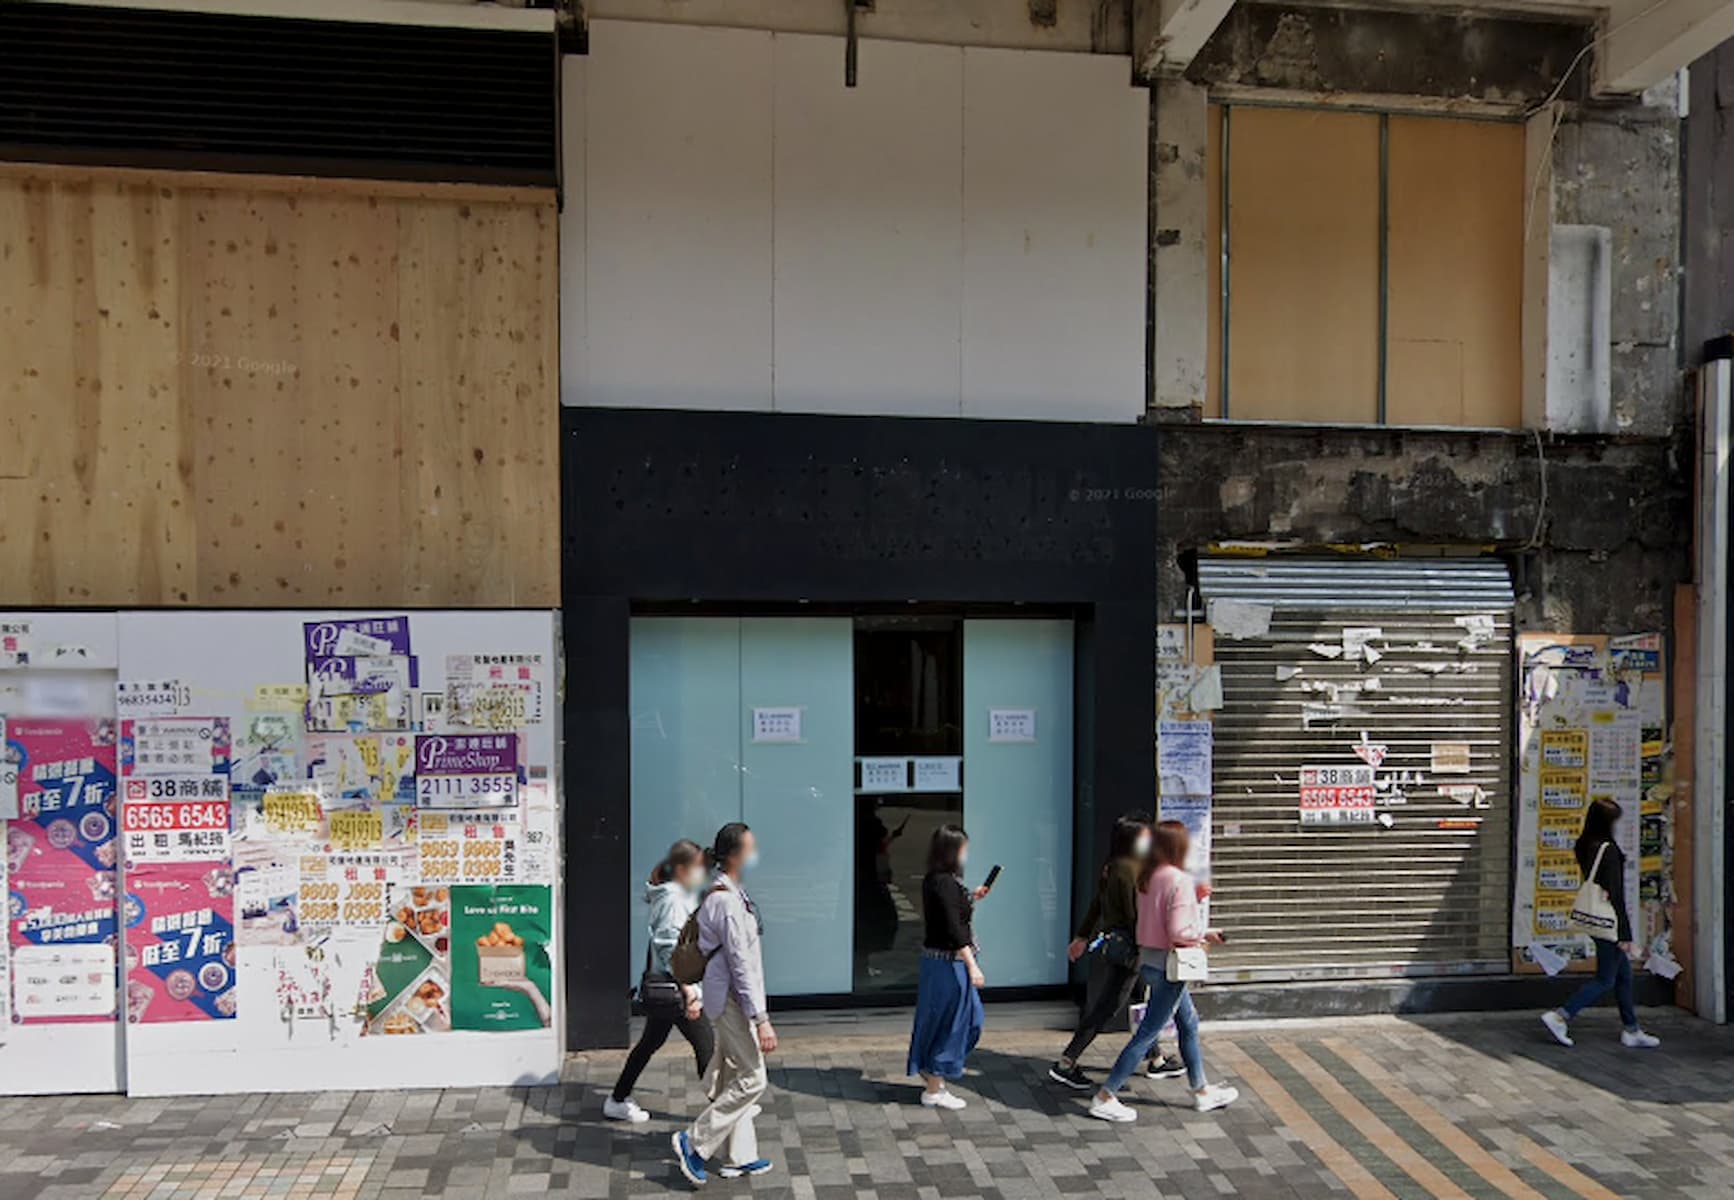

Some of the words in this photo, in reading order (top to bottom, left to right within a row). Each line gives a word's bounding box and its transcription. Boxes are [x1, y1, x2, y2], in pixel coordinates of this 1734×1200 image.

[422, 779, 461, 794] 2111
[471, 777, 513, 792] 3555
[127, 805, 174, 828] 6565
[180, 804, 226, 827] 6543
[464, 905, 486, 914] Love
